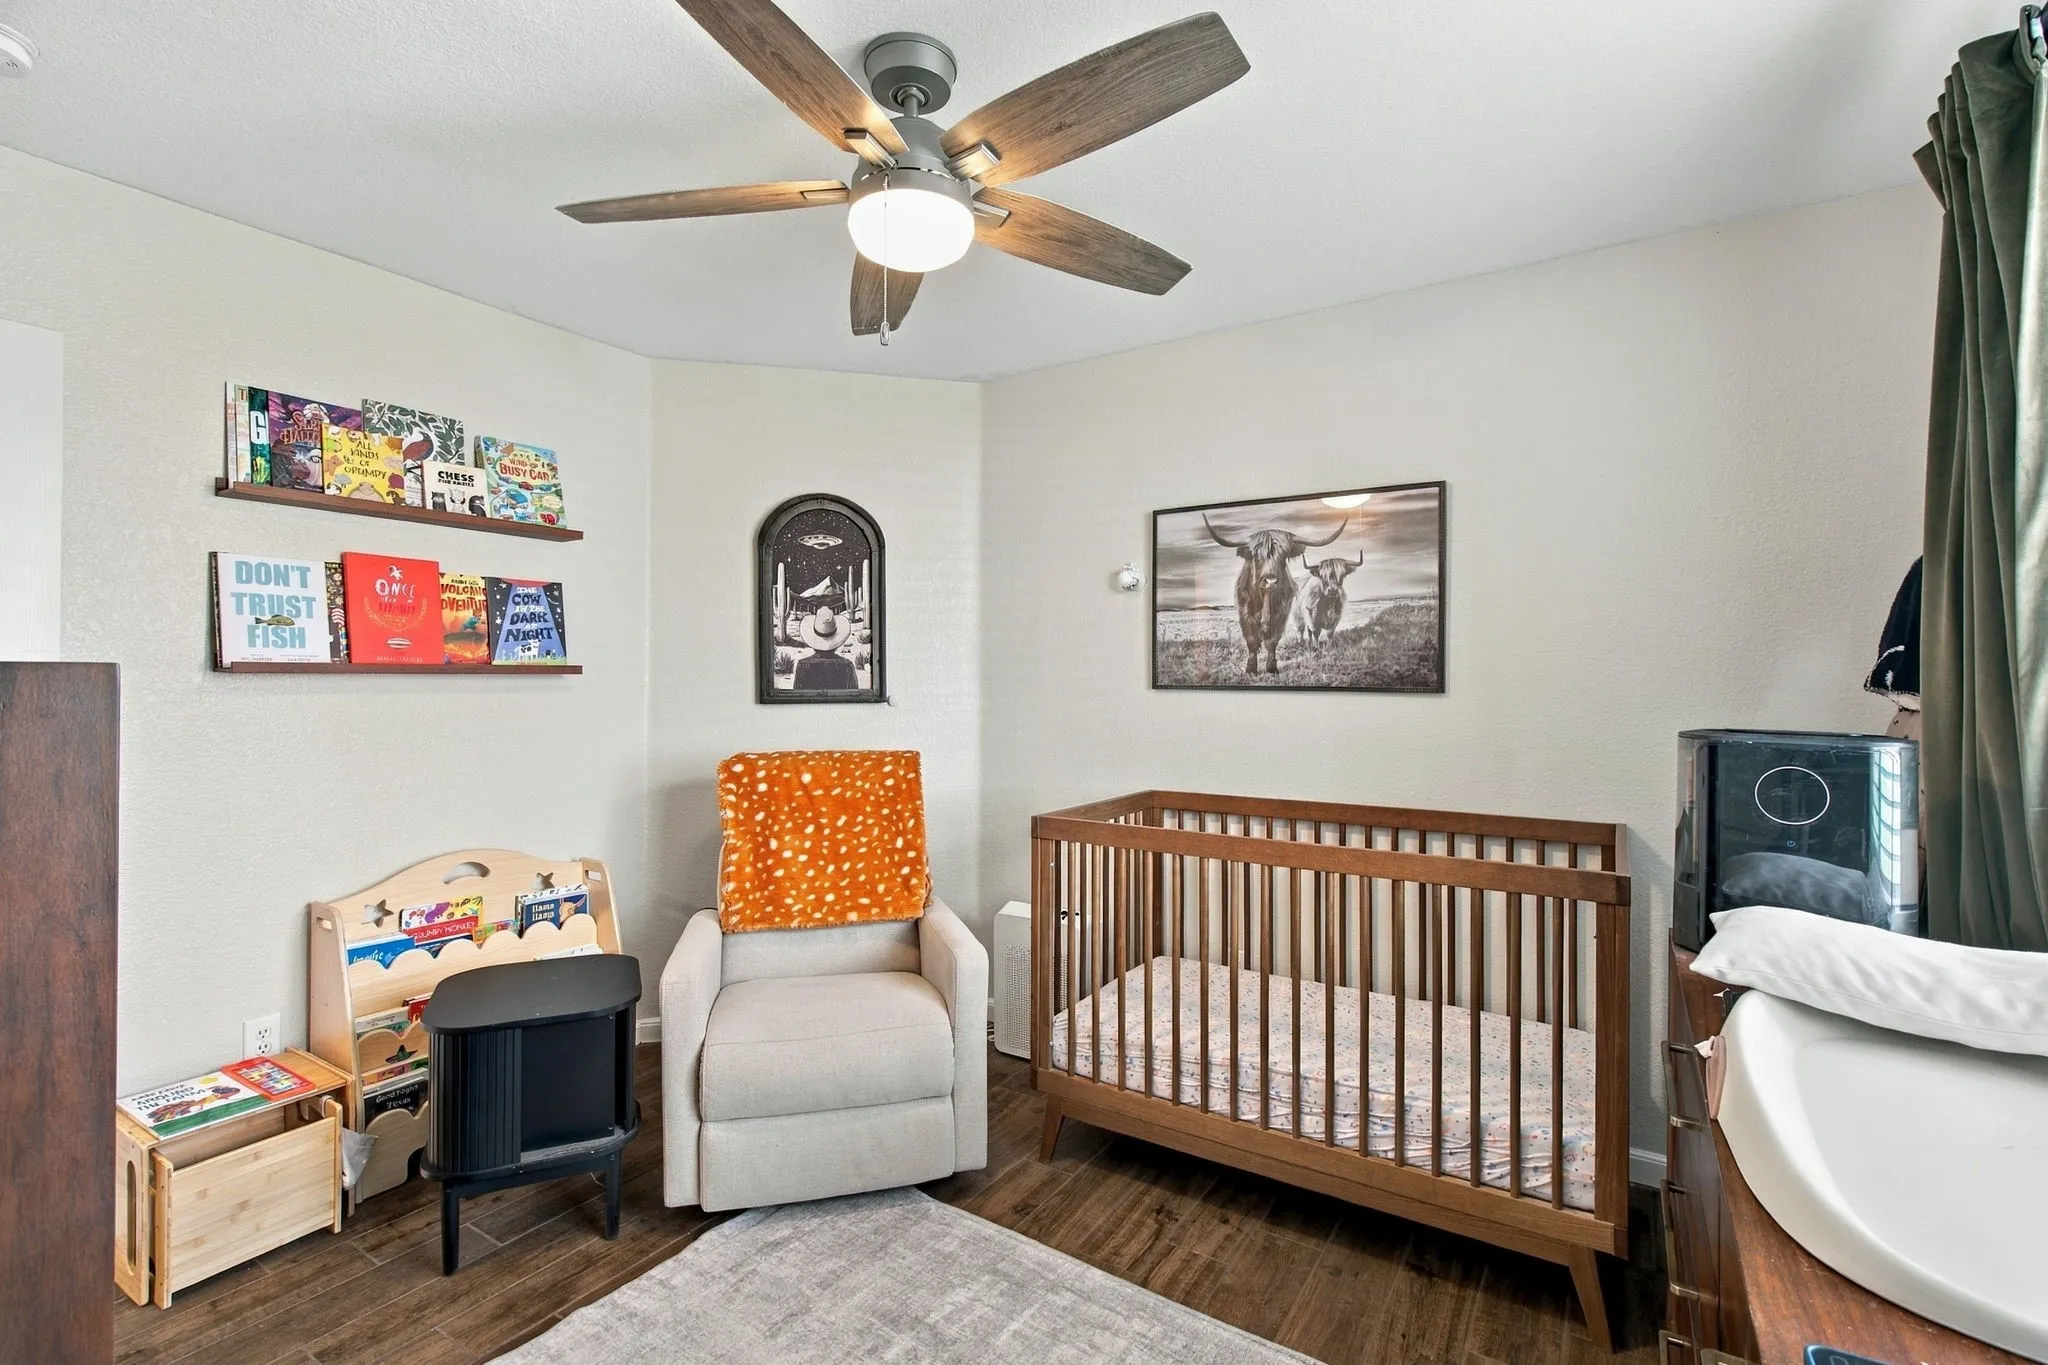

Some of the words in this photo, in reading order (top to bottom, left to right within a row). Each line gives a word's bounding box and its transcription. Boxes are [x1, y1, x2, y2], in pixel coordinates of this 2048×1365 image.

[249, 410, 269, 445] G
[357, 441, 372, 451] ALL
[350, 448, 379, 460] KINDS
[344, 465, 388, 479] GRUMPY
[438, 470, 475, 483] CHESS
[500, 463, 527, 478] BUSY
[529, 469, 550, 482] CAR
[235, 560, 311, 589] DON'T
[375, 578, 416, 598] ONCE
[441, 584, 488, 597] VOLCANO
[516, 586, 538, 594] THE
[230, 592, 317, 619] TRUST
[441, 596, 488, 612] DVENTUR
[511, 593, 542, 606] COW
[509, 612, 549, 625] DARK
[247, 624, 306, 649] FISH
[504, 627, 554, 643] NIGHT
[531, 903, 555, 914] llama
[531, 911, 555, 922] llama
[444, 920, 476, 934] MONKEY
[137, 1086, 195, 1106] AROUND
